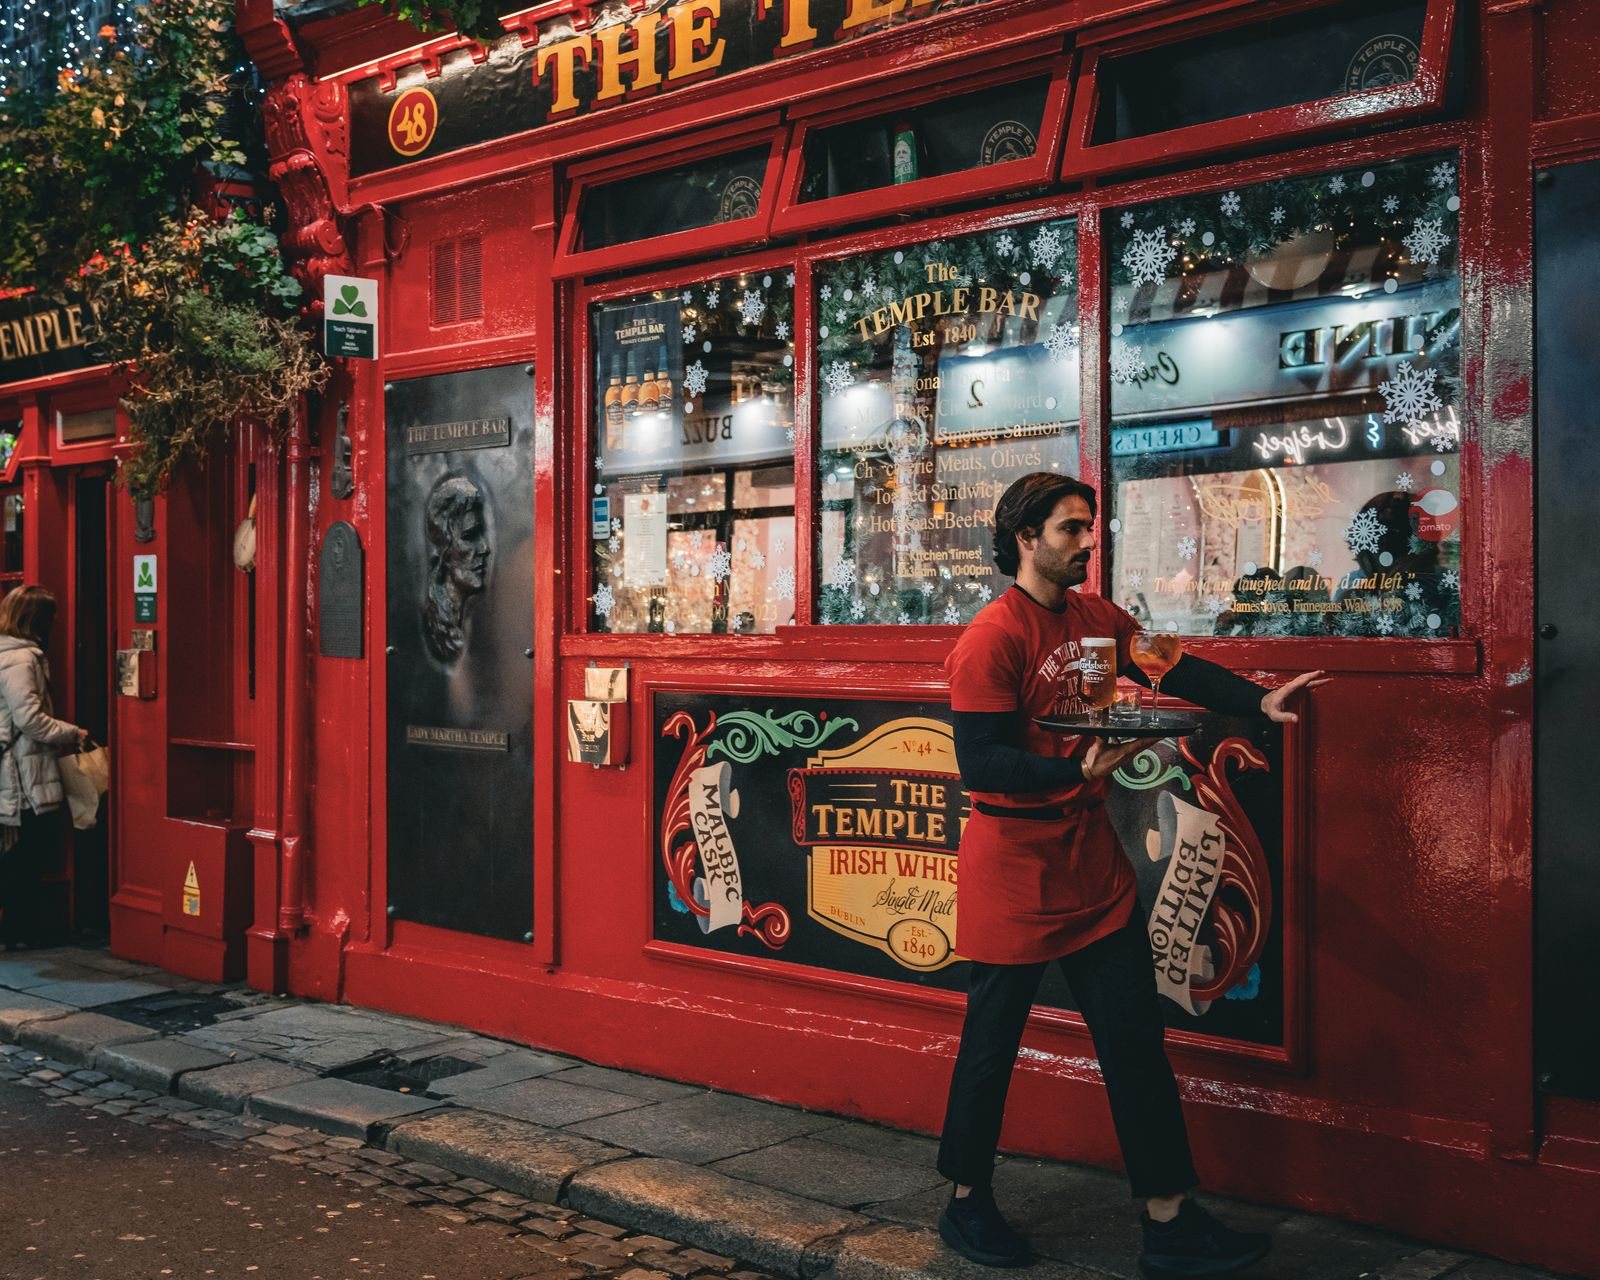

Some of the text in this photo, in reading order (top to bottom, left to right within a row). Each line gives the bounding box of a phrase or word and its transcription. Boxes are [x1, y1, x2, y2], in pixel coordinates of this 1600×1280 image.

[537, 0, 727, 114] THE
[1359, 40, 1408, 63] TEMPLE
[396, 104, 429, 145] 48
[988, 125, 1024, 144] TEMPLE
[924, 262, 959, 284] The
[632, 318, 647, 327] THE
[853, 286, 1041, 343] TEMPLE BAR
[0, 302, 88, 361] EMPLE
[614, 323, 666, 341] TEMPLE BAR
[912, 324, 977, 349] Est 1840
[407, 418, 508, 443] THE TEMPLE BAR
[937, 421, 998, 445] Smoked
[1003, 417, 1062, 439] Salmon
[937, 454, 987, 473] Meats,
[991, 448, 1042, 469] Olives
[874, 484, 927, 505] Toaed
[871, 514, 897, 533] Hot
[944, 509, 980, 529] Beef
[949, 548, 981, 560] Times
[951, 564, 993, 578] 10:00pm
[1237, 574, 1287, 596] laughed
[1288, 574, 1312, 591] and
[1351, 572, 1378, 590] and
[1231, 600, 1260, 613] James
[1292, 598, 1343, 616] Finnegans
[1038, 654, 1060, 683] THE
[431, 728, 468, 743] MARTHA
[469, 731, 507, 746] TEMPLE
[890, 779, 947, 808] THE
[811, 803, 947, 843] TEMPLE
[694, 811, 723, 886] CASK
[702, 783, 740, 903] MALBEC
[828, 848, 958, 885] IRISH WHIS
[872, 877, 924, 916] Single
[1151, 837, 1199, 975] EDITION
[1166, 830, 1221, 986] LIMITED
[830, 905, 866, 928] DUBLIN
[903, 937, 936, 959] 1840
